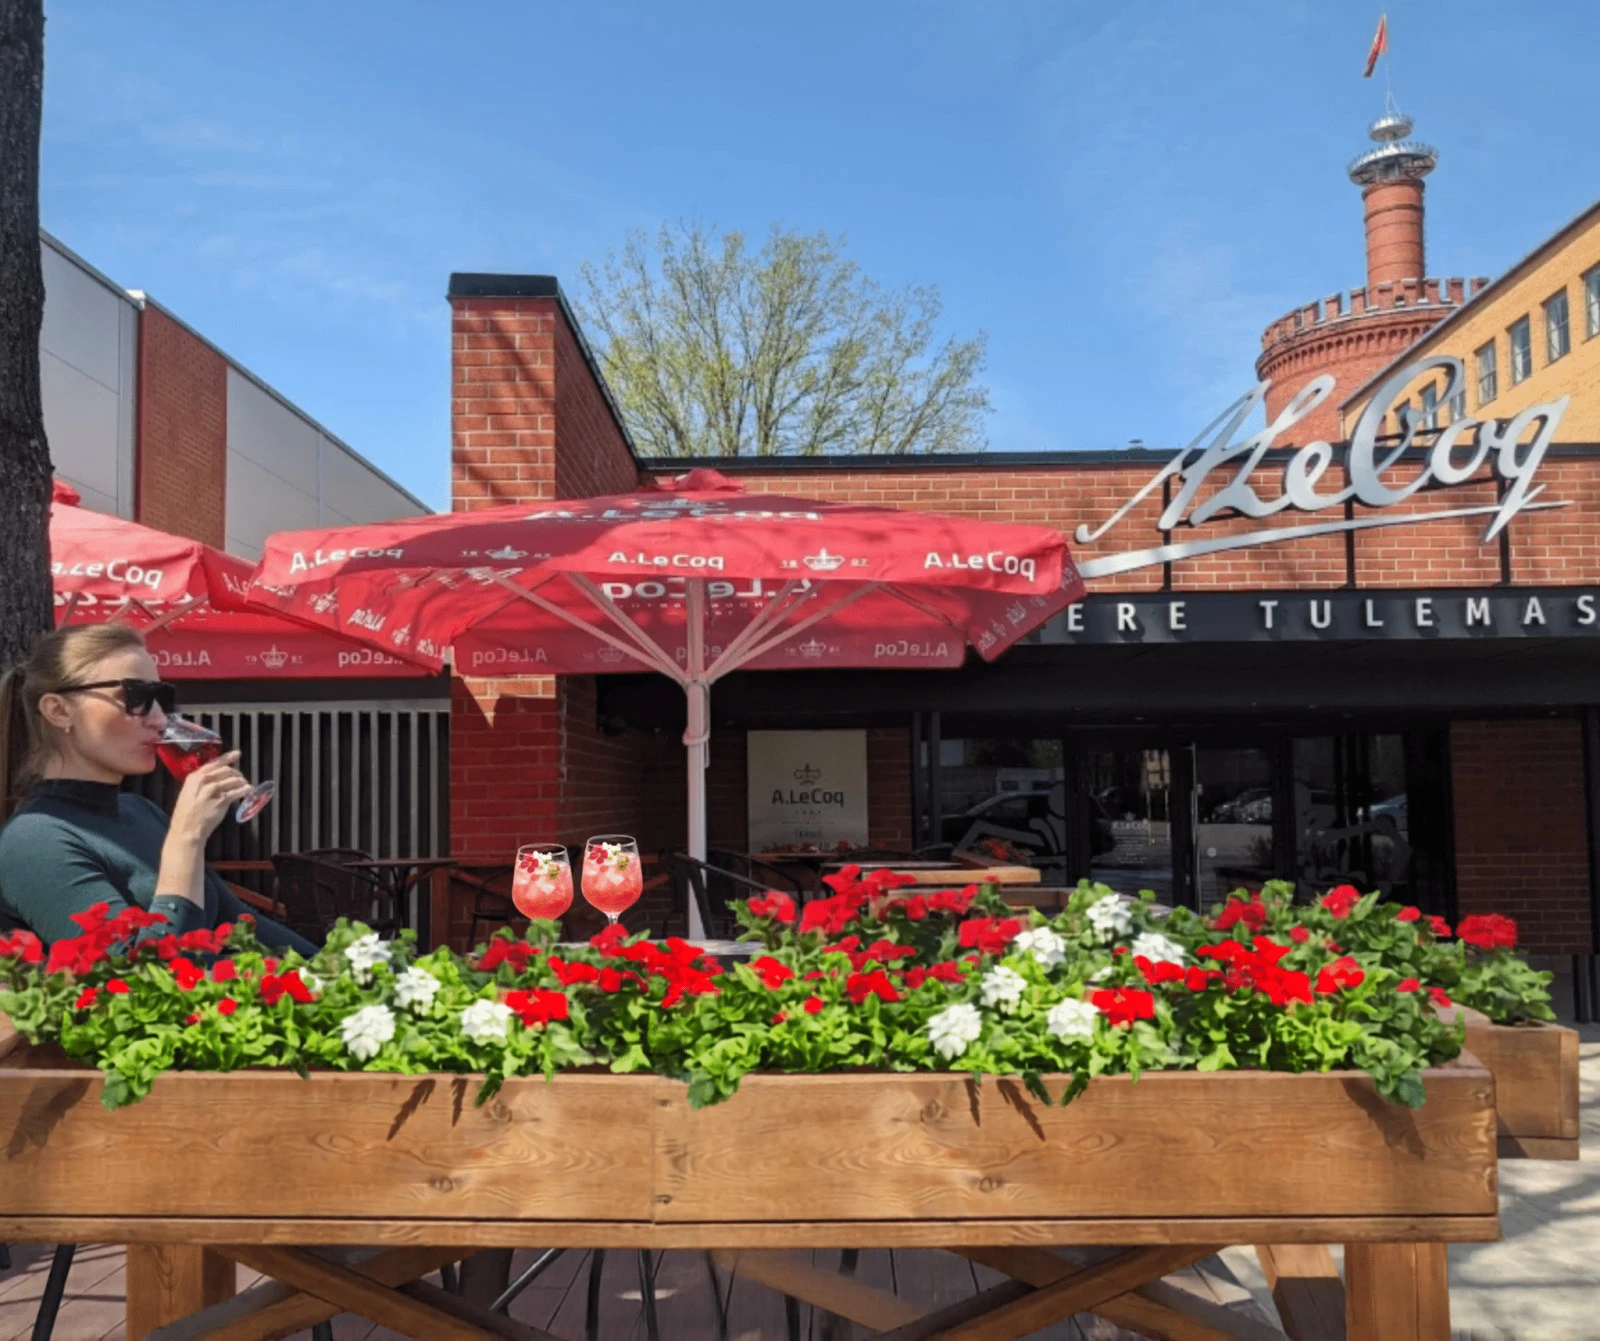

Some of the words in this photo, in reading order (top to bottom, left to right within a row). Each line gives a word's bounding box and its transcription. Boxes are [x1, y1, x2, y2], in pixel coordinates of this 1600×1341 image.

[923, 551, 1037, 581] A.LeCoq
[1067, 600, 1188, 632] ERE
[771, 788, 845, 807] A.LeCoq
